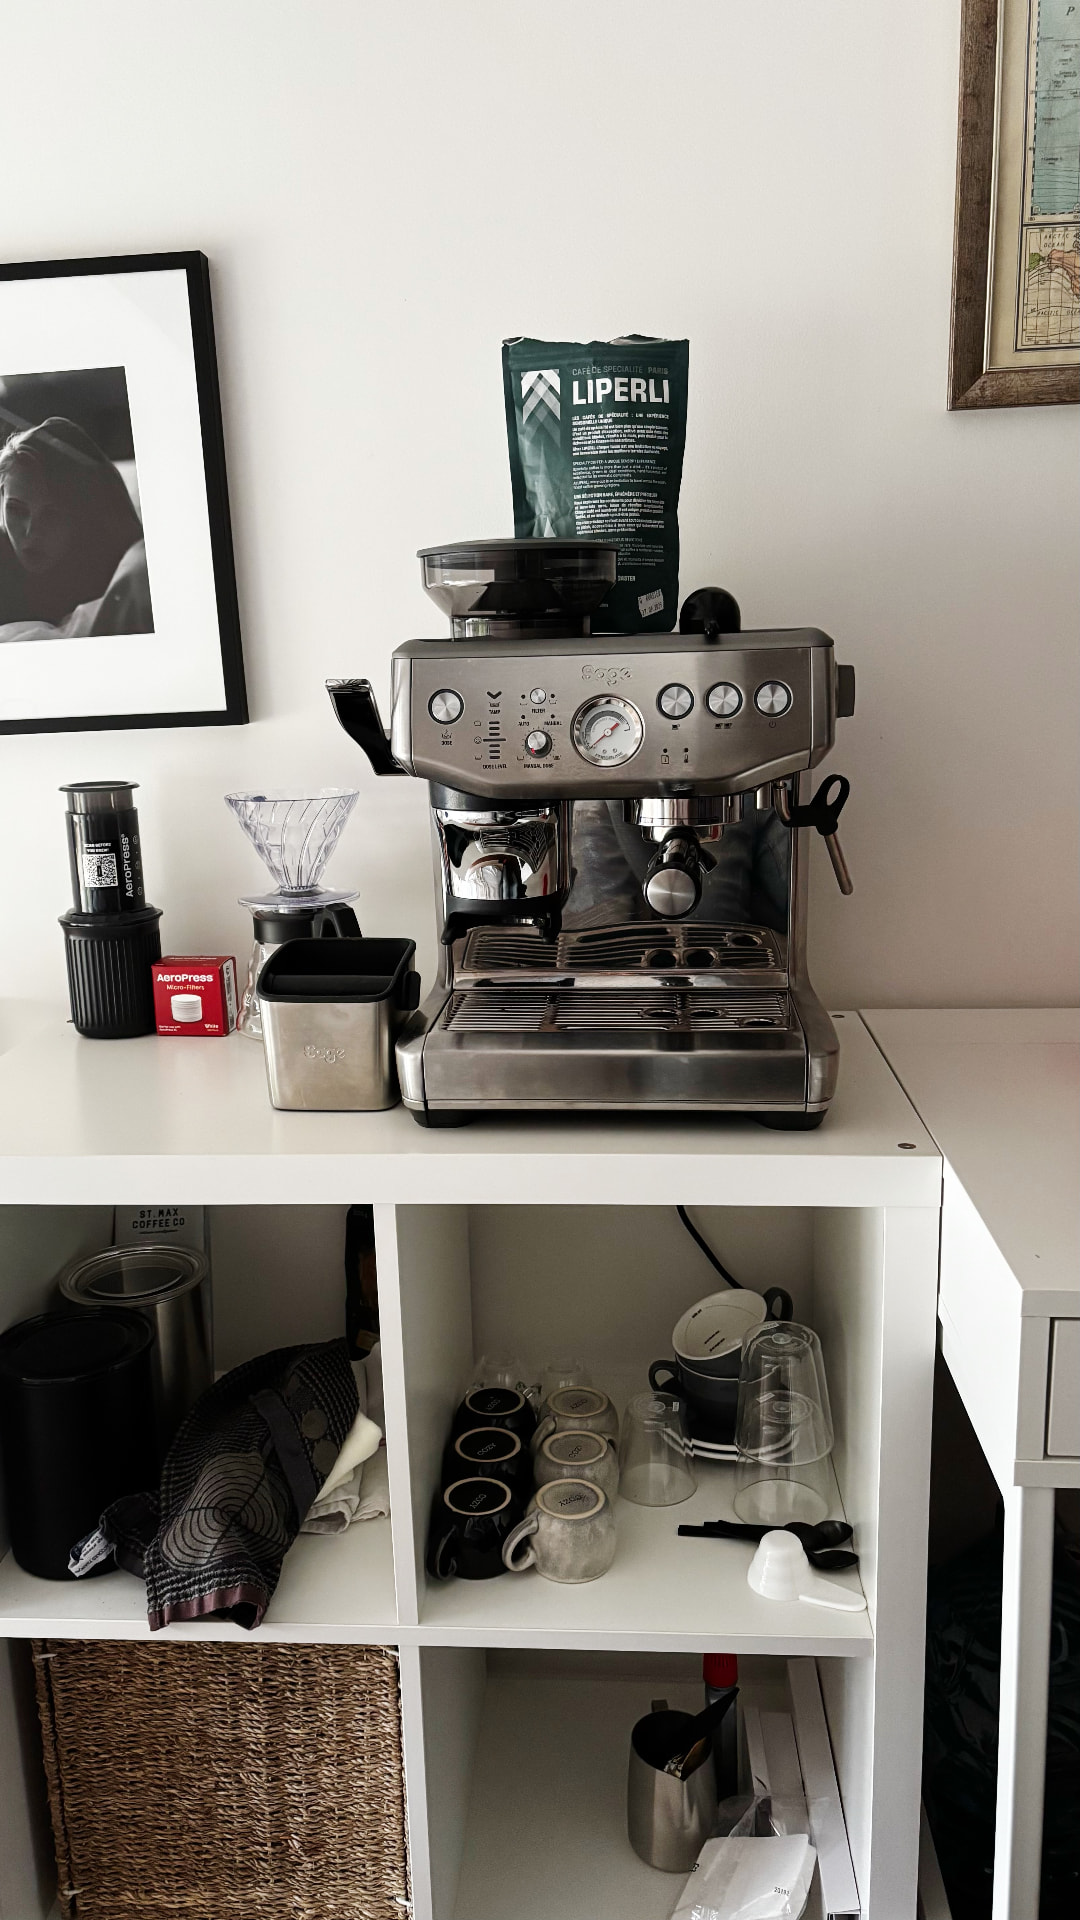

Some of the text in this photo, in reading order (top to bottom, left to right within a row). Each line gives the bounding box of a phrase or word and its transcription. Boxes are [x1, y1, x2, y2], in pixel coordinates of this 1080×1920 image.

[647, 366, 669, 375] PARIS
[572, 377, 670, 405] LIPERLI
[121, 836, 134, 898] AeroPress
[157, 973, 214, 982] AeroPress
[139, 1208, 179, 1219] ST. MAX
[132, 1217, 185, 1229] COFFEE CO
